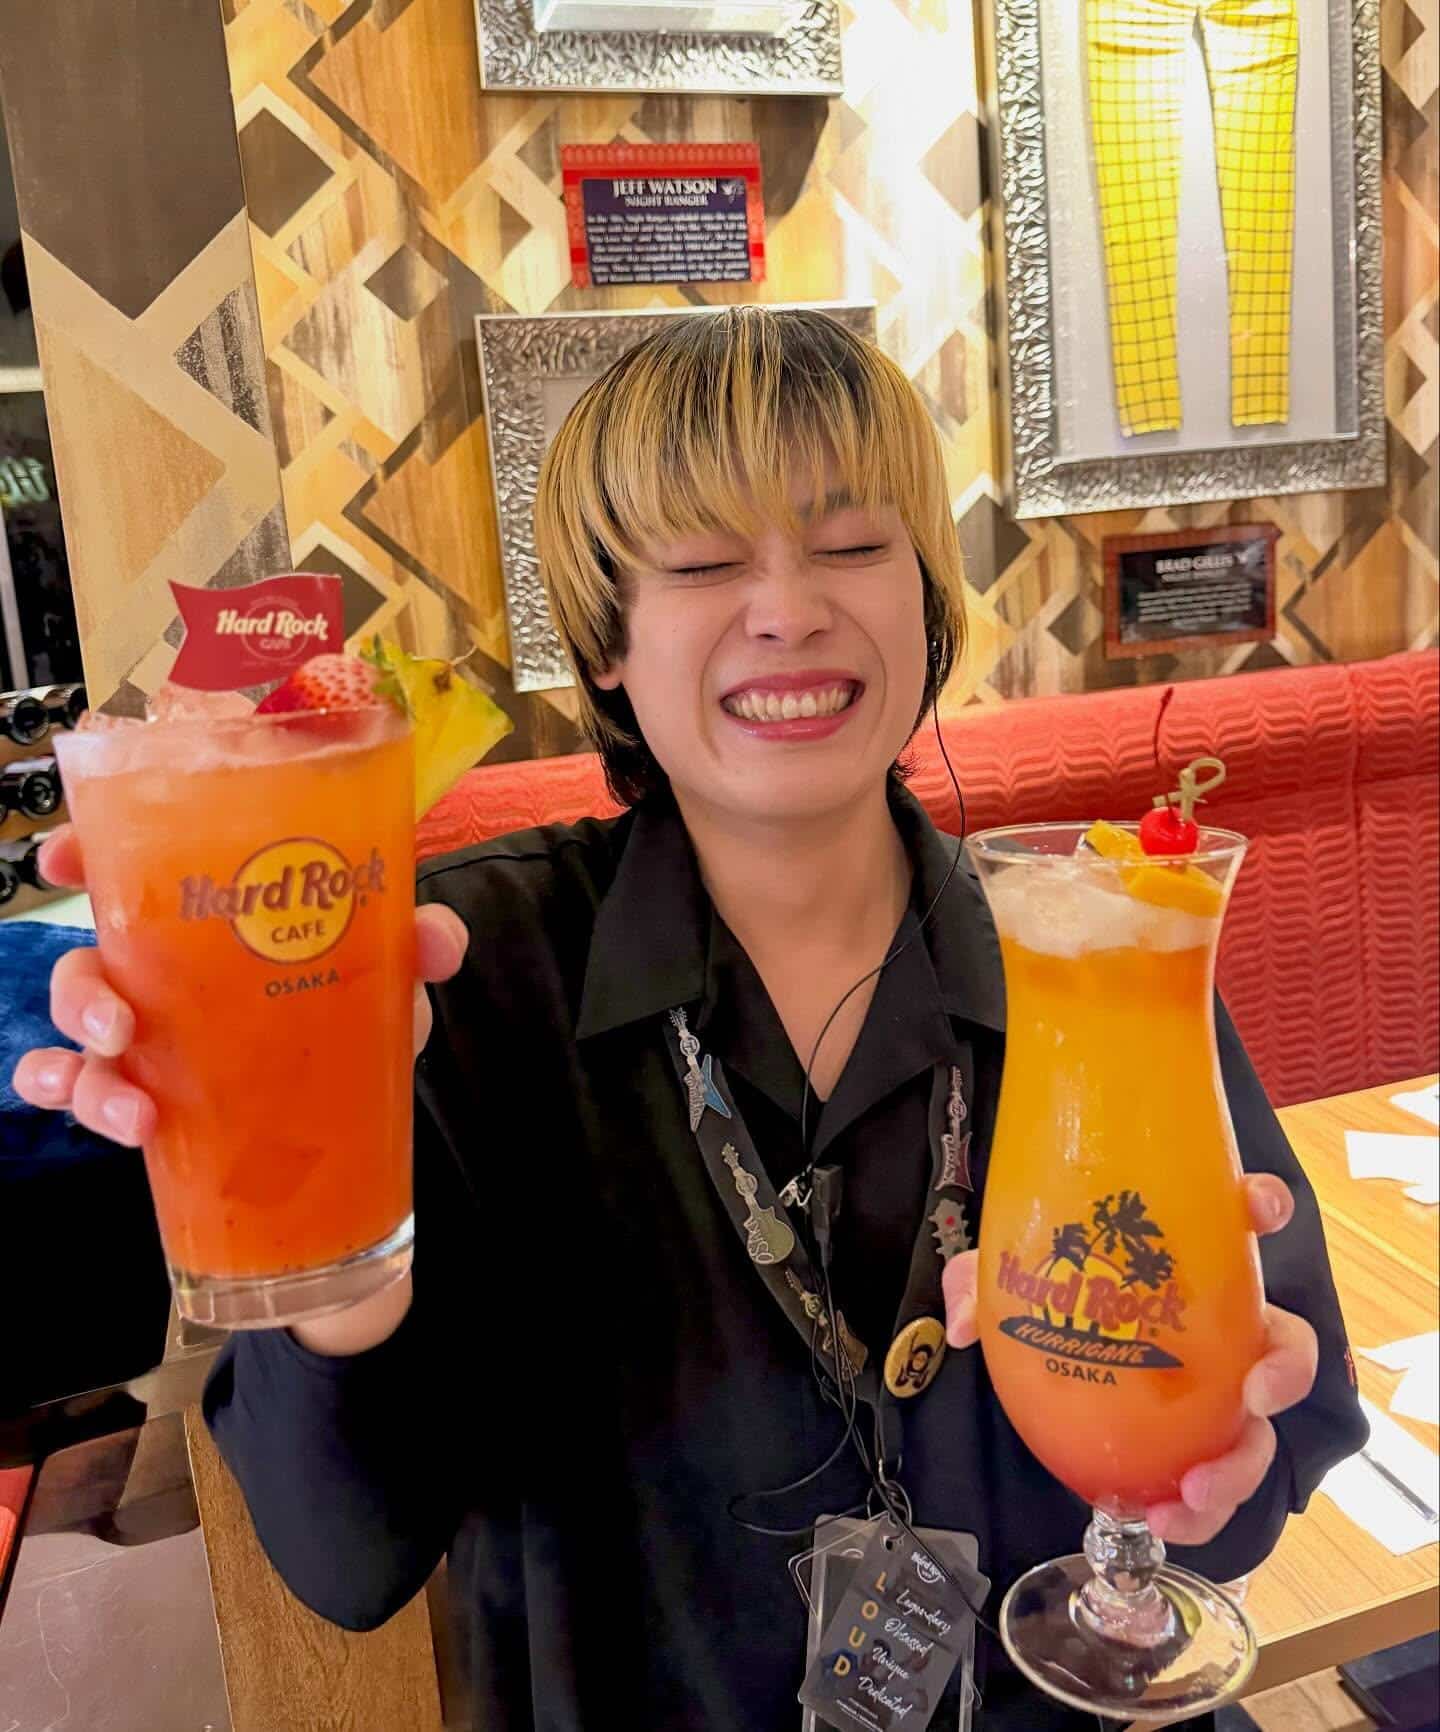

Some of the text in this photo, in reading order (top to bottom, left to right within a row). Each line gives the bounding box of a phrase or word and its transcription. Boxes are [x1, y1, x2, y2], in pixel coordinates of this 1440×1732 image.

[613, 177, 717, 198] JEFF WATSON
[625, 195, 662, 208] NIGHT
[216, 609, 328, 640] Hard Rock
[180, 847, 385, 921] Hard Rock
[271, 919, 326, 944] CAFE
[265, 968, 340, 998] OSAKA
[997, 1250, 1187, 1333] Hard Rock
[1014, 1322, 1151, 1364] HURRICANE
[1045, 1358, 1117, 1386] OSAKA
[872, 1646, 911, 1680] Unique
